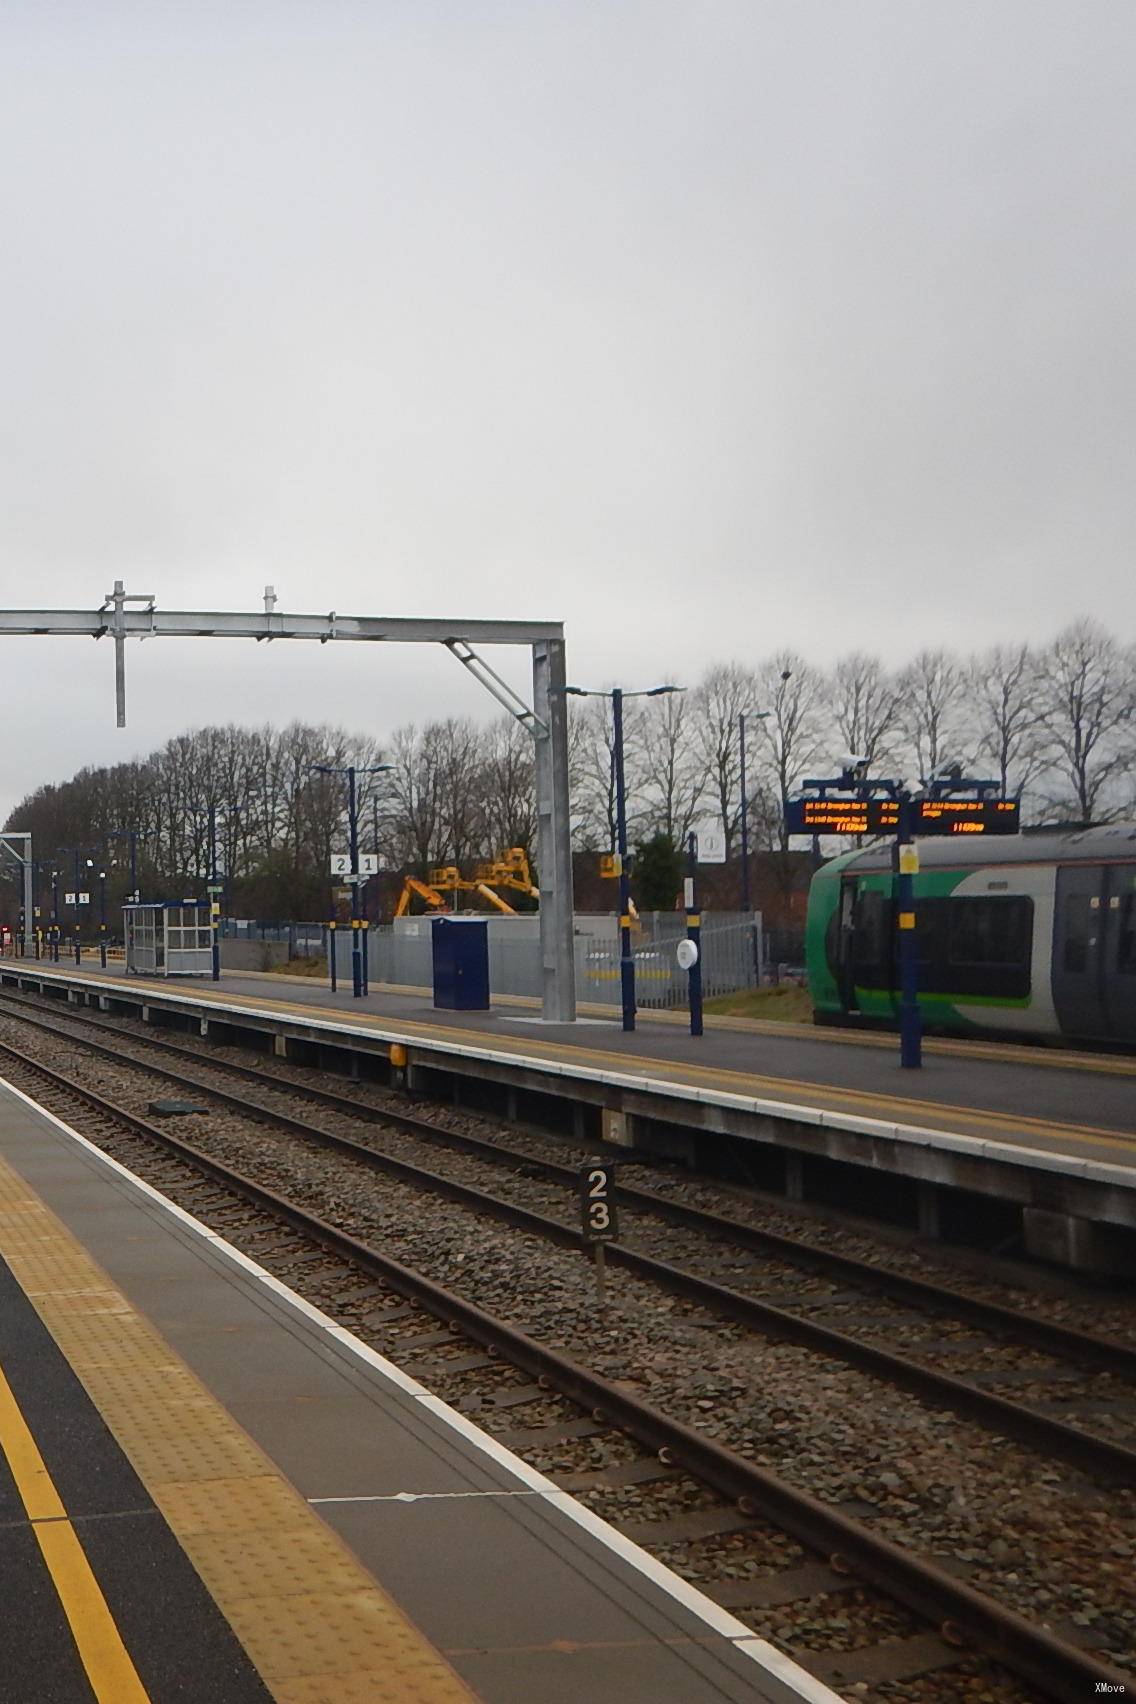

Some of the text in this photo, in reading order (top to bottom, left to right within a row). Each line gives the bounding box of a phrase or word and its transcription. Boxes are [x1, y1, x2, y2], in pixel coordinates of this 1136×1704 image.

[337, 858, 346, 871] 2
[364, 858, 373, 871] 1
[588, 1170, 607, 1197] 2
[589, 1202, 610, 1230] 3
